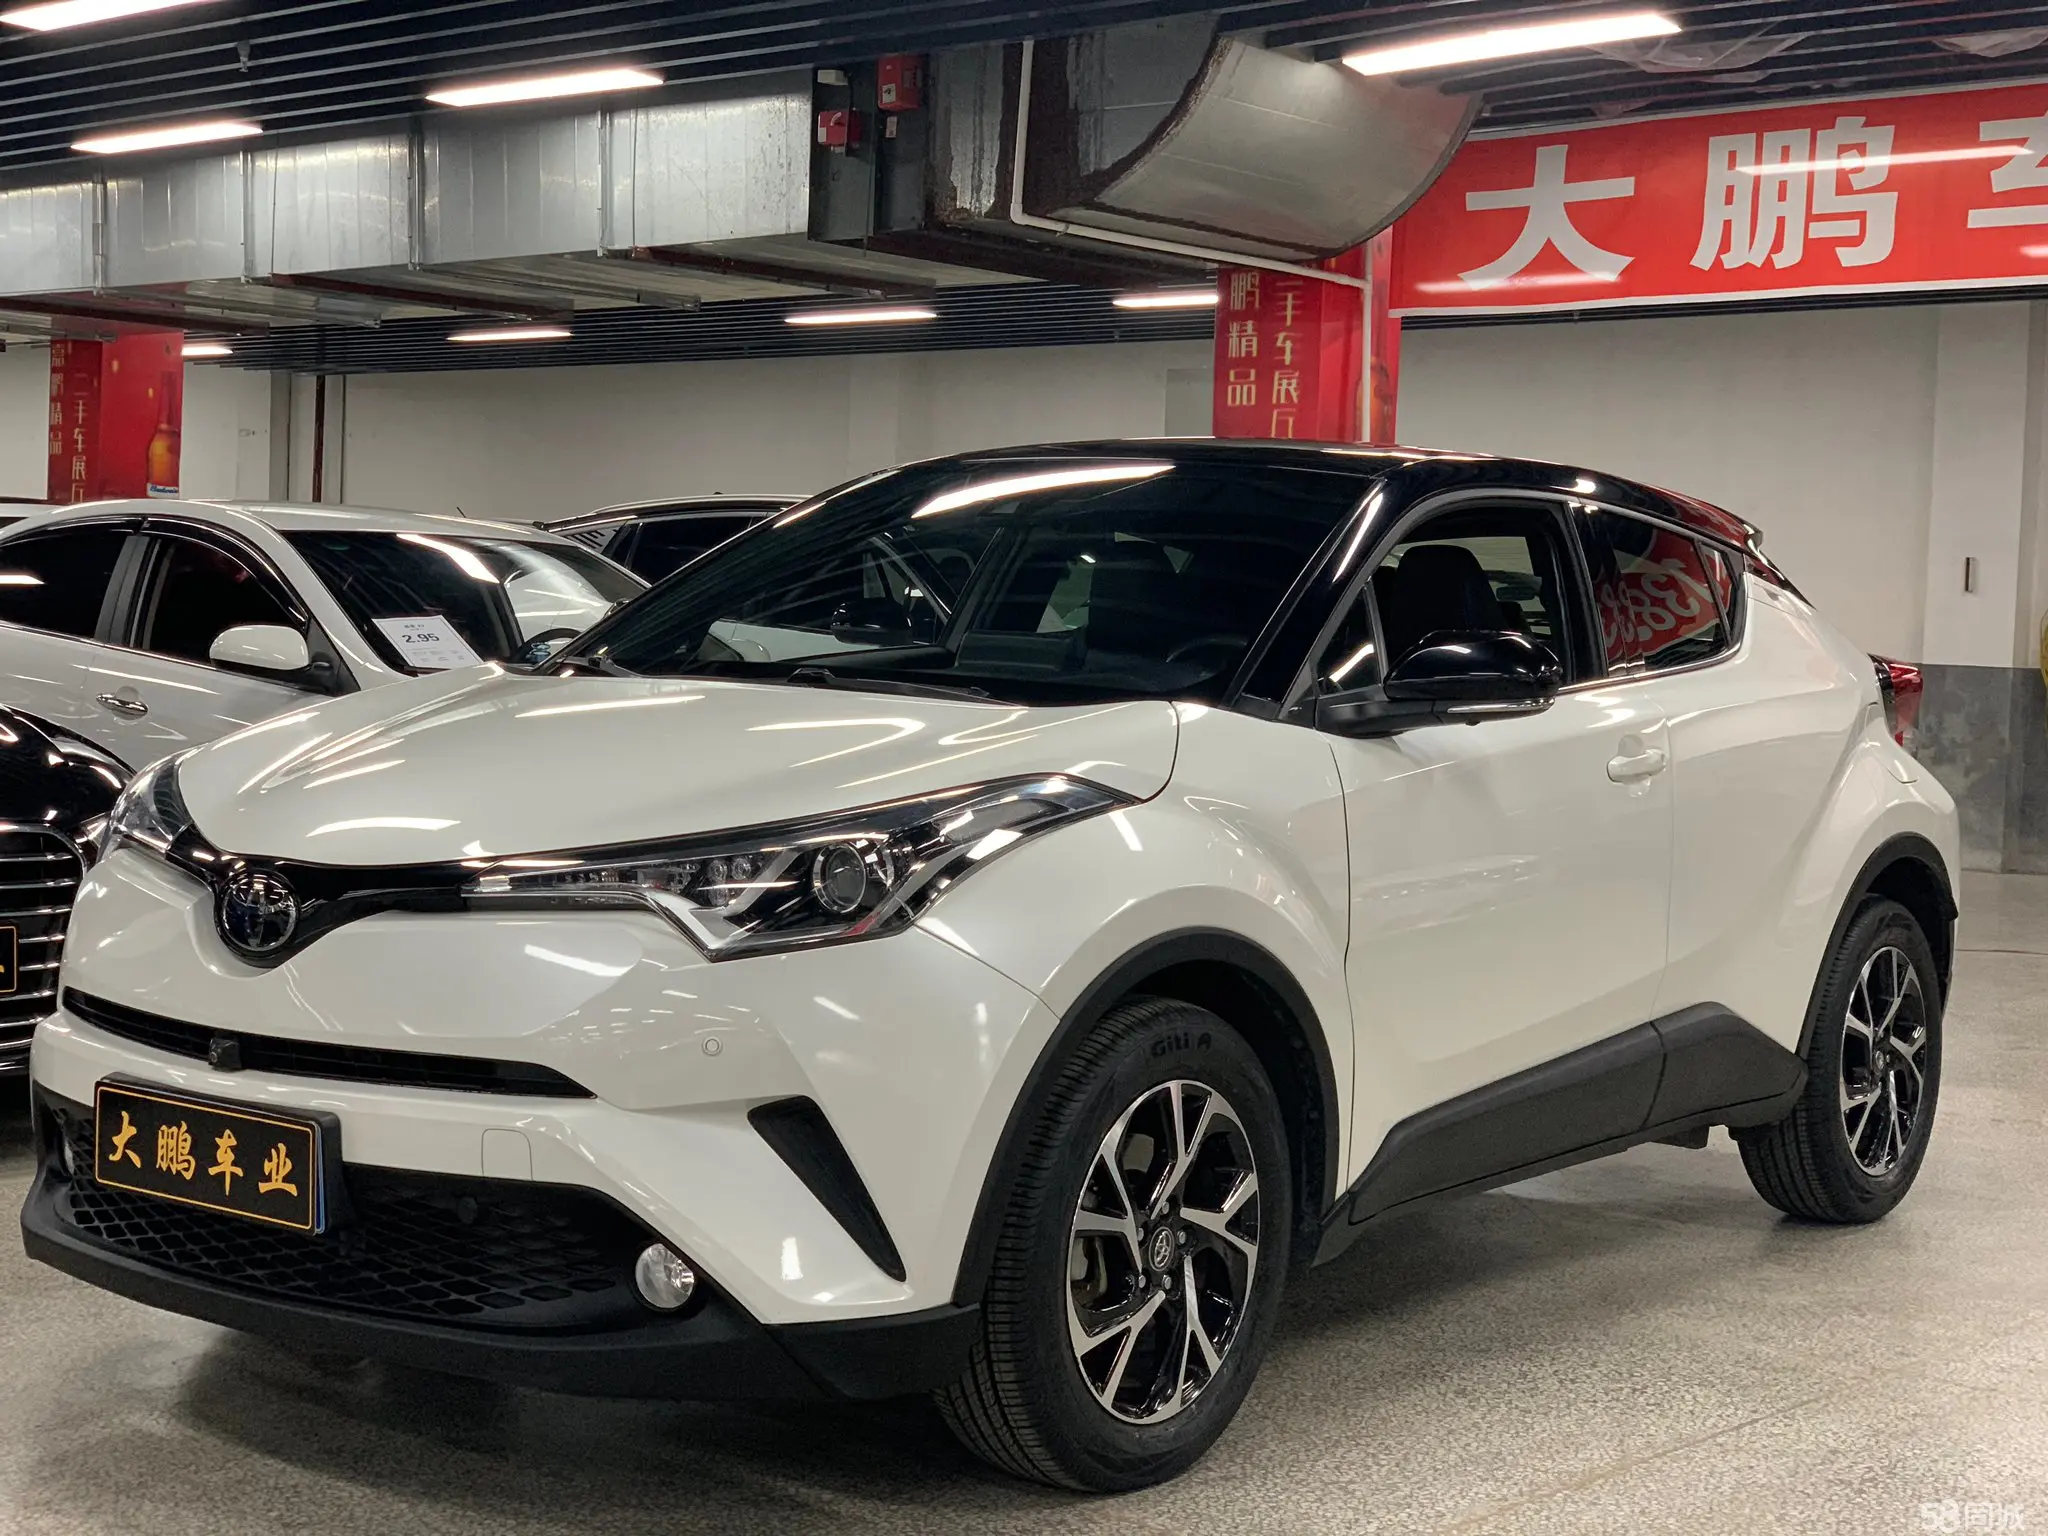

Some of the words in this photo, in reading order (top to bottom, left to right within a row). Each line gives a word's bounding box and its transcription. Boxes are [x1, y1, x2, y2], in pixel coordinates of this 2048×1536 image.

[1226, 272, 1261, 407] 鹏精品
[71, 373, 89, 503] 二手车展厅
[402, 632, 440, 644] 2.95
[108, 1110, 298, 1197] 大鹏车业
